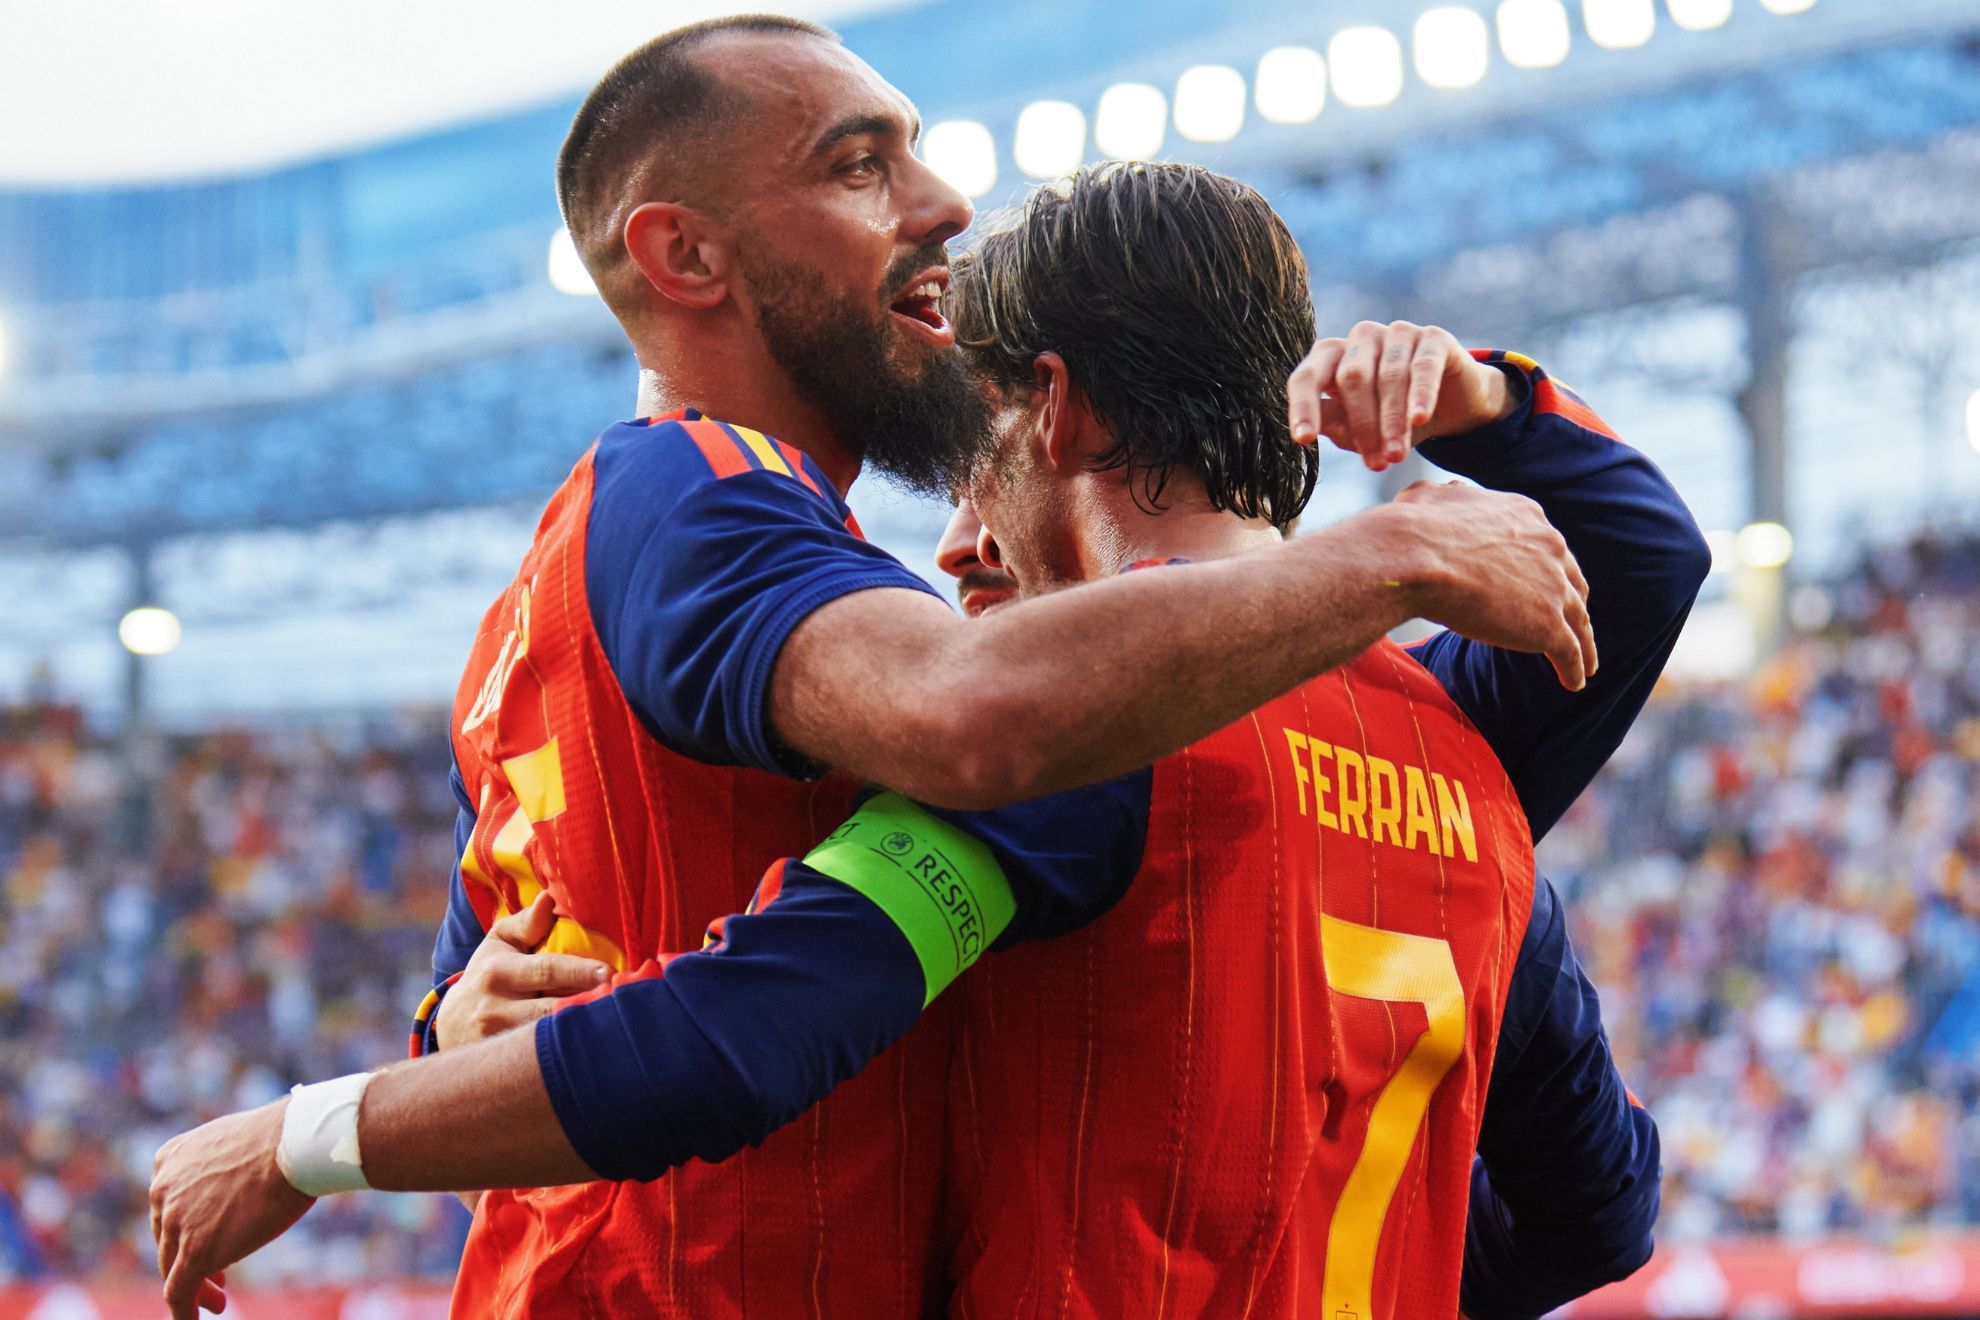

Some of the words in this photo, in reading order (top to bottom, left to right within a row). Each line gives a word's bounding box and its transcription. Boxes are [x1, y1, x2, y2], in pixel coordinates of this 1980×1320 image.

[1283, 727, 1478, 863] FERRAN
[914, 853, 981, 963] RESPECT
[1320, 912, 1465, 1320] 7
